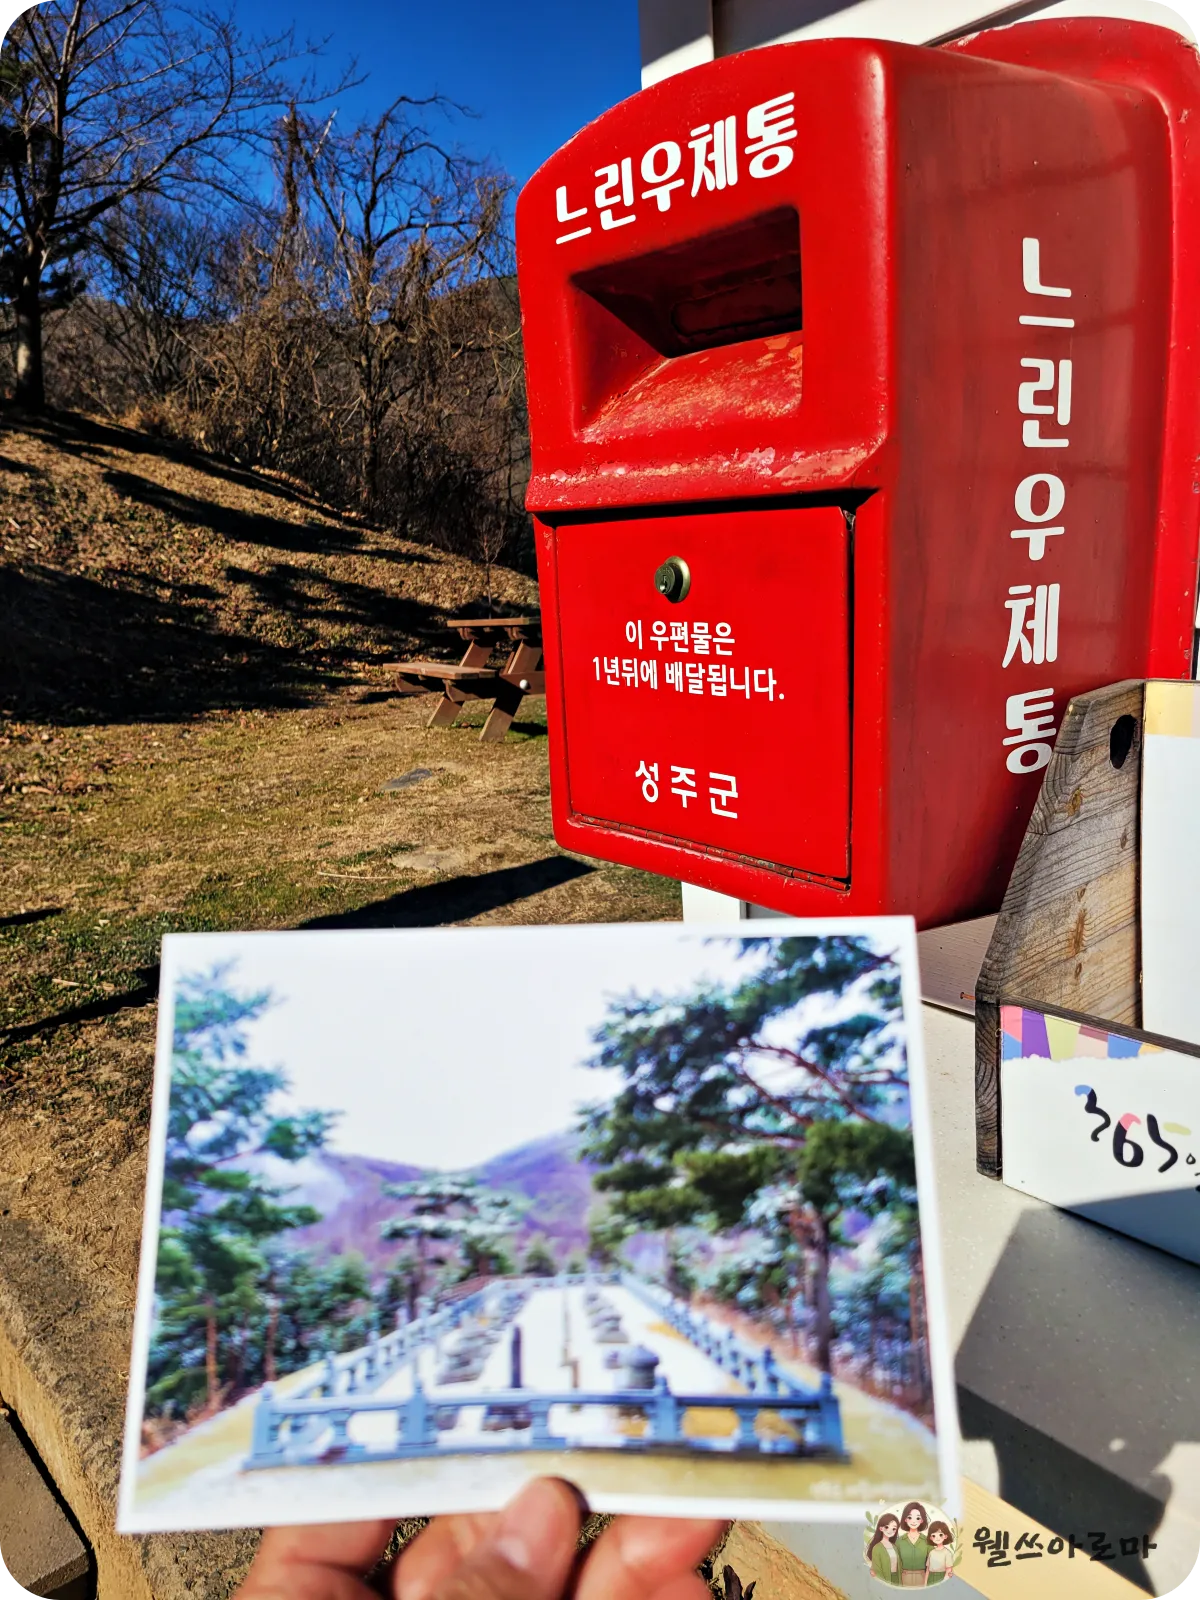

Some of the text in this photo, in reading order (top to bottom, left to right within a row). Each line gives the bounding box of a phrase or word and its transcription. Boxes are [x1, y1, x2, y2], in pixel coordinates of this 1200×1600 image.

[555, 91, 798, 245] 느린우체통
[1002, 237, 1075, 774] 느린우체통
[592, 656, 785, 702] 1년뒤에 배달됩니다.
[625, 619, 736, 656] 이 우편물은
